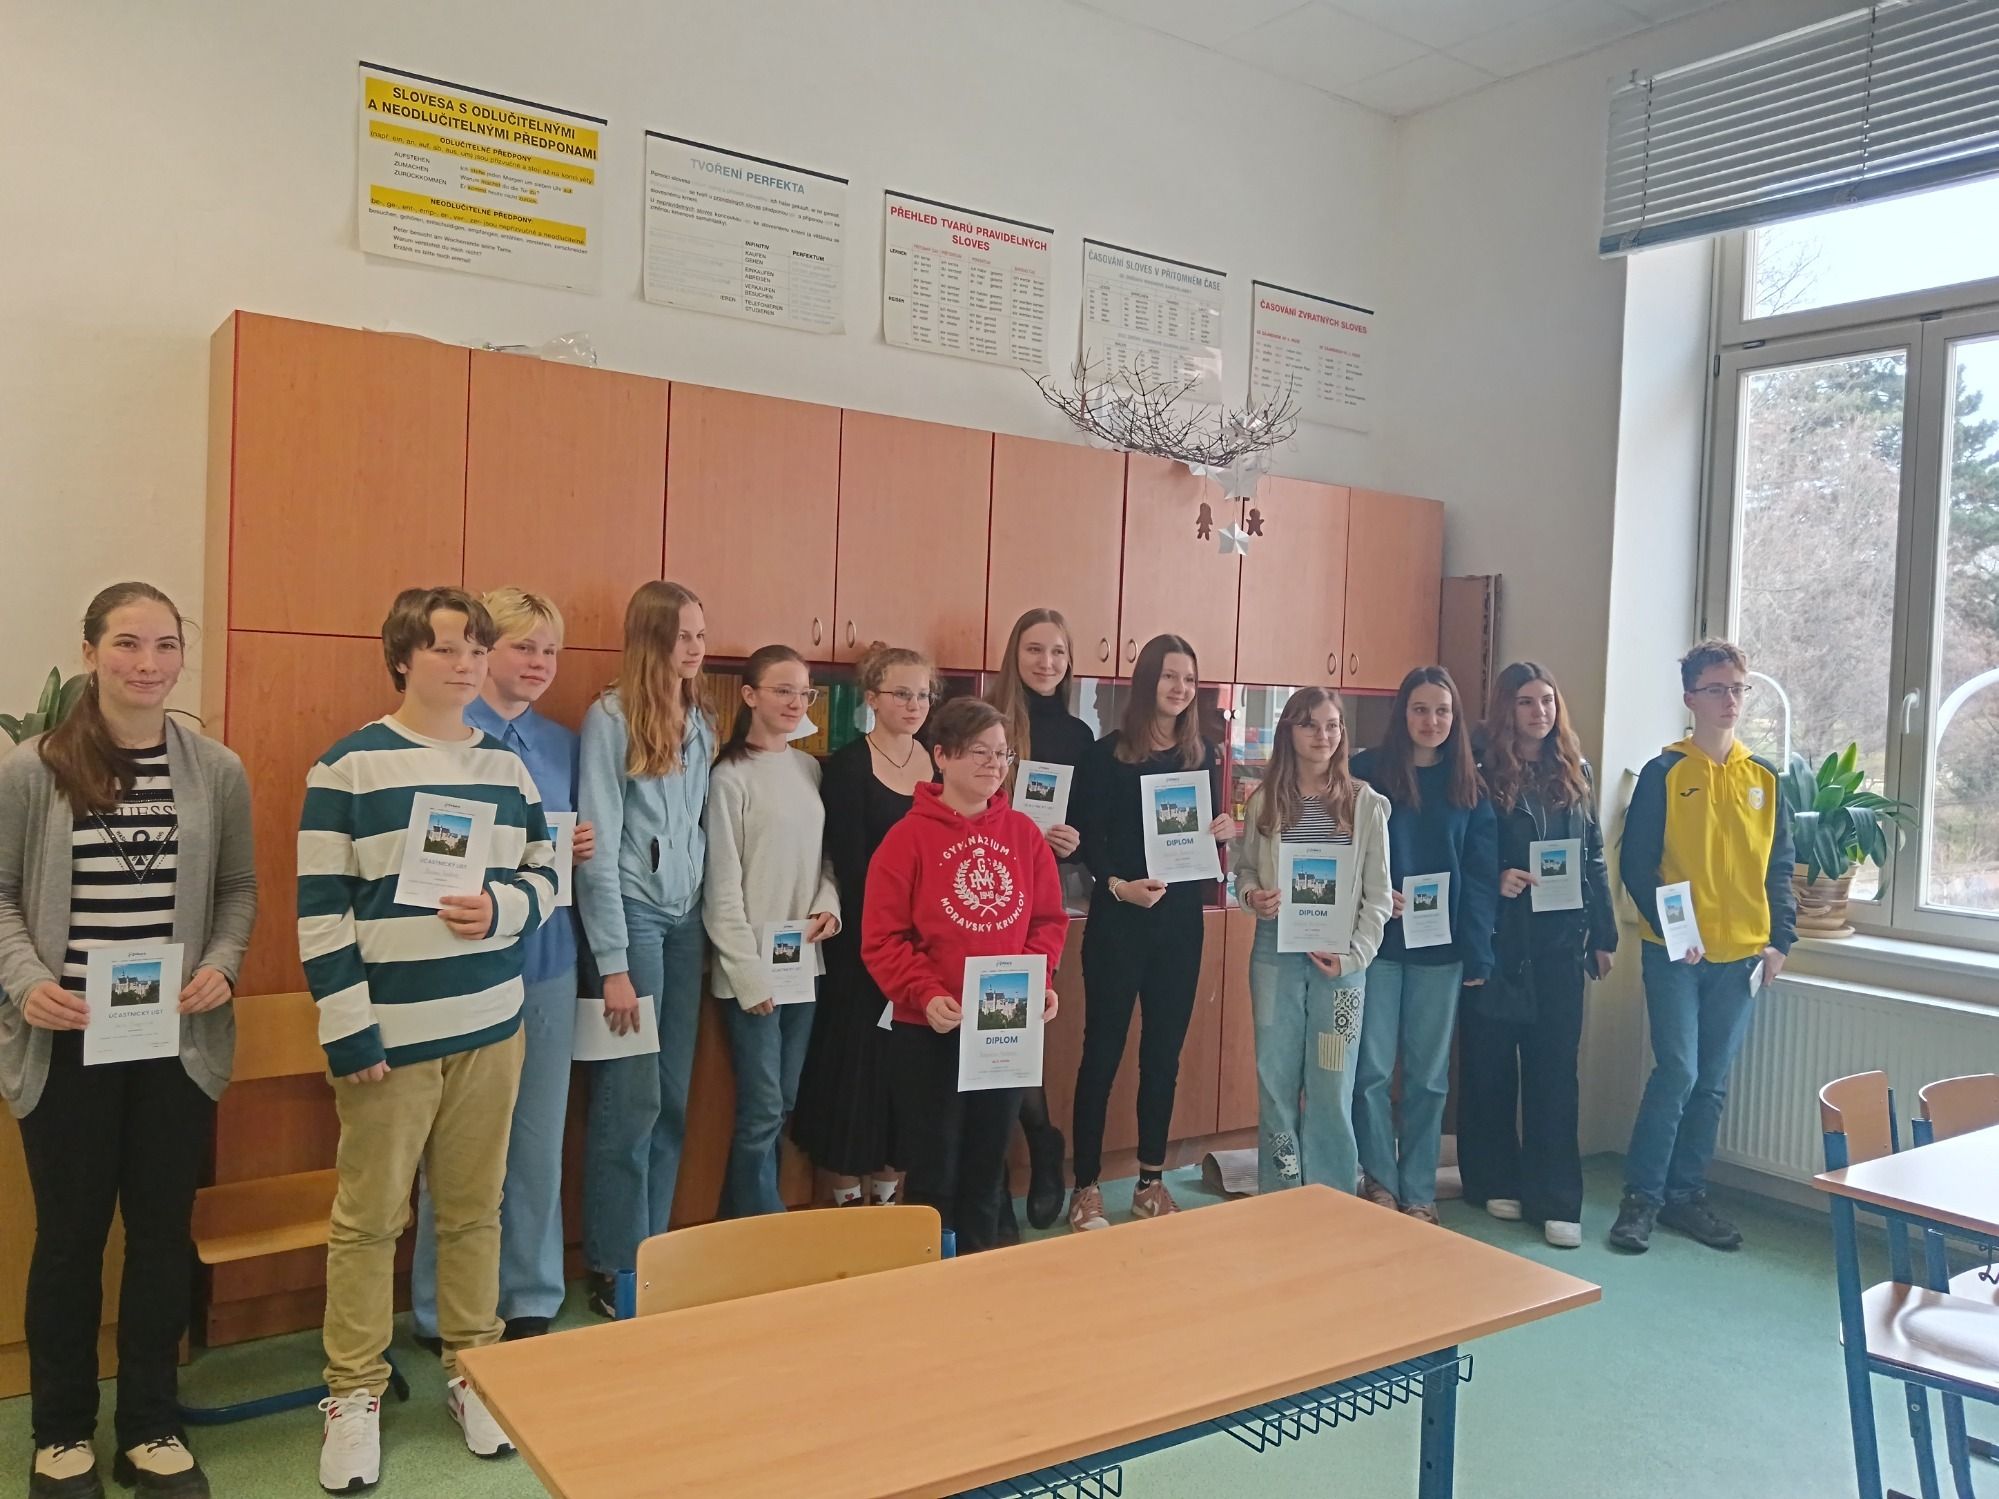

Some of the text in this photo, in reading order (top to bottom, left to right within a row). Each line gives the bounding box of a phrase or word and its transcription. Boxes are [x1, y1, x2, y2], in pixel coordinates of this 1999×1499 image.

[393, 87, 575, 140] SLOVESA S ODLUČITELNÝMI
[368, 98, 597, 160] A NEODLUČITELNÝMI PŘEDPONAMI
[394, 152, 430, 164] AUFSTEHEN
[440, 137, 532, 162] ODLUČITELNÉ PŘEDPONY
[394, 161, 429, 173] ZUMACHEN
[690, 158, 743, 180] TVOŘENÍ
[746, 171, 805, 194] PERFEKTA
[430, 198, 532, 224] NEODLUČITELNÉ PŘEDPONY
[890, 205, 938, 226] PŘEHLED
[941, 217, 973, 234] TVARŮ
[976, 226, 1048, 251] PRAVIDELNÝCH
[952, 234, 990, 251] SLOVES
[792, 250, 825, 262] PERFEKTUM
[1088, 250, 1124, 268] ČASOVÁNÍ
[1126, 260, 1153, 275] SLOVES
[1154, 267, 1160, 276] V
[1161, 267, 1202, 287] PŘÍTOMNÉM
[1204, 276, 1221, 291] ČASE
[1260, 298, 1367, 335] ČASOVÁNÍ ZVRATNÝCH SLOVES
[943, 833, 1010, 859] GYMNÁZIUM
[1166, 838, 1194, 847] DIPLOM
[940, 890, 1024, 933] MORAVSKÝ KRUMLOV
[1298, 909, 1328, 918] DIPLOM
[985, 1035, 1019, 1045] DIPLOM
